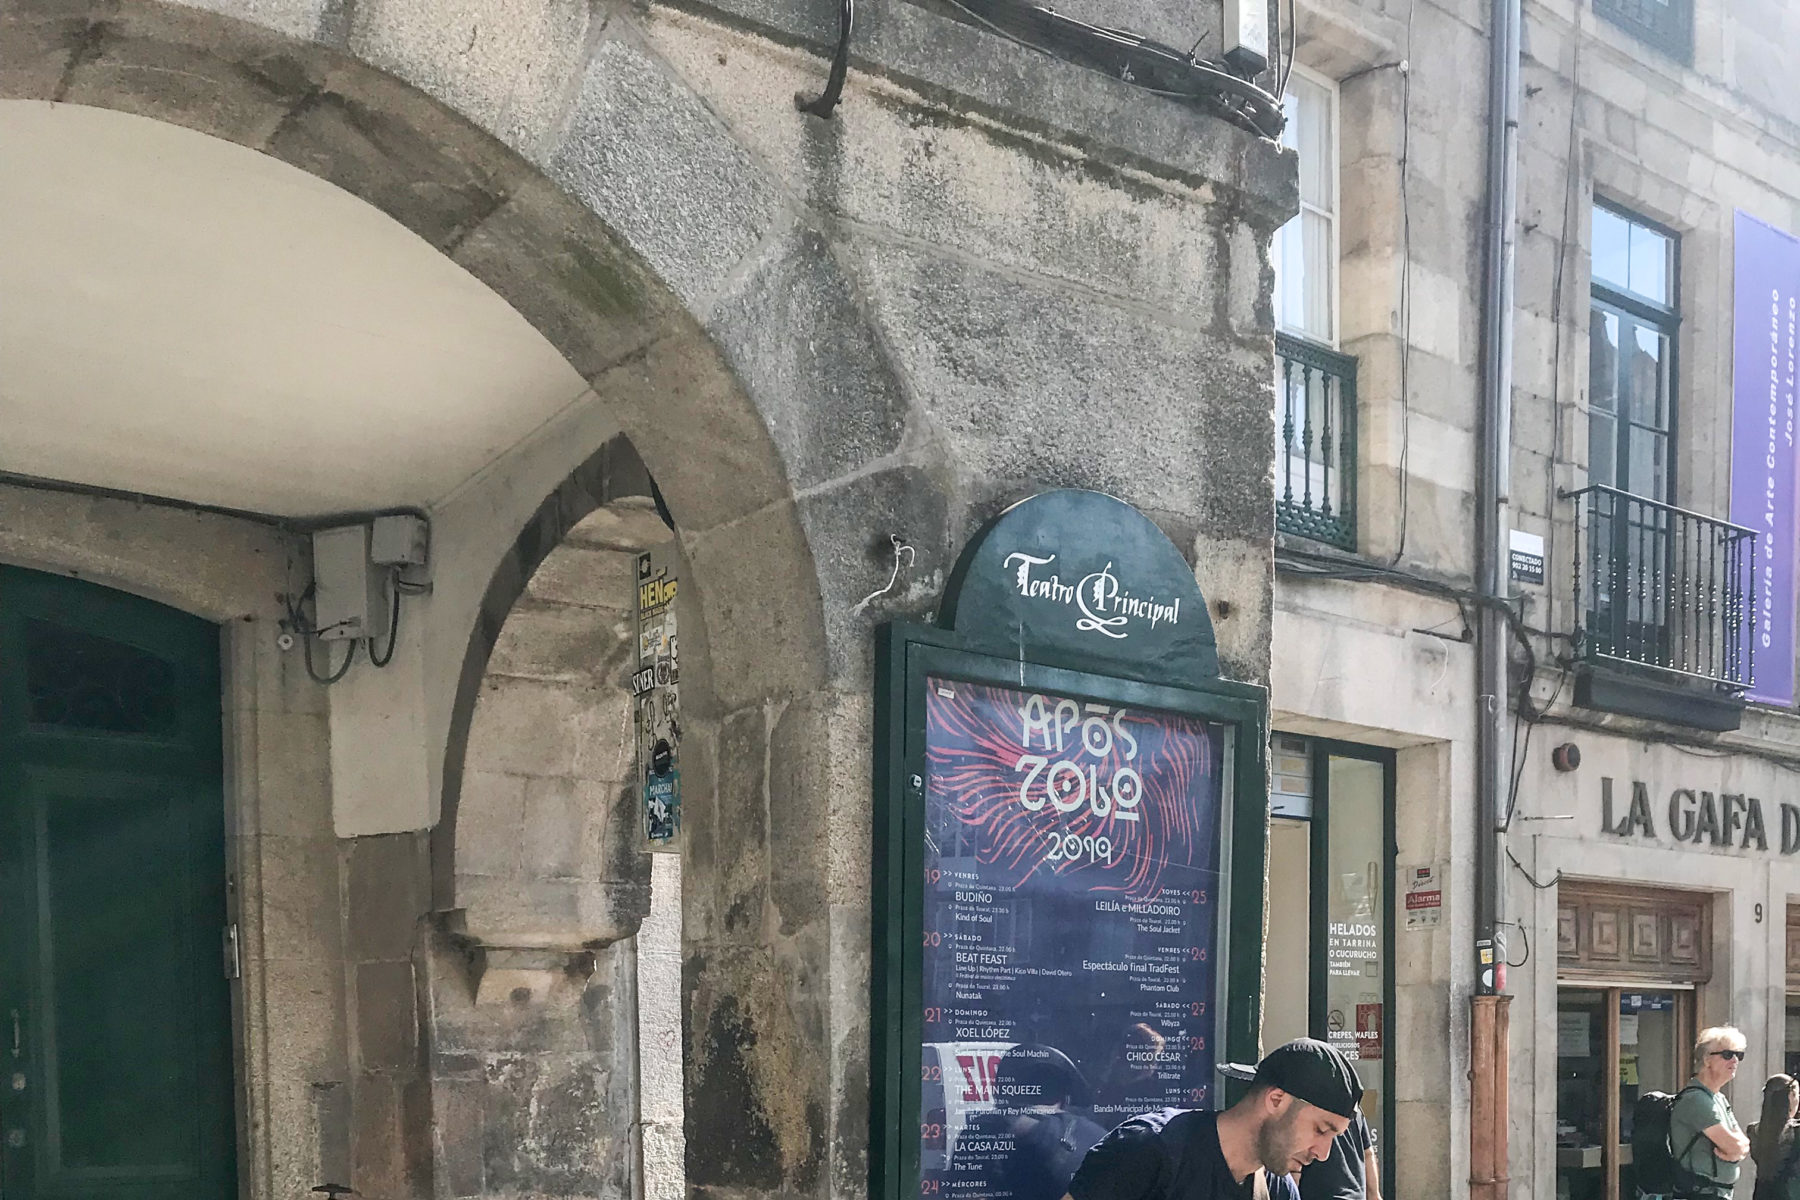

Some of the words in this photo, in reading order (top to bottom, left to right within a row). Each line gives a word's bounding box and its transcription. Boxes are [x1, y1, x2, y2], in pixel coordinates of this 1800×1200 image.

[1786, 297, 1796, 387] Lorenzo
[1767, 288, 1779, 469] Contemporáneo
[1785, 392, 1794, 448] José
[1765, 477, 1775, 527] Arte
[1764, 532, 1773, 559] de
[1004, 552, 1073, 604] Teatro
[1076, 561, 1180, 638] Principal
[1601, 777, 1656, 838] LA
[1669, 788, 1769, 850] GAFA
[1048, 832, 1111, 865] 2019
[924, 868, 941, 884] 19
[954, 872, 979, 880] VENRES
[955, 891, 992, 903] BUDIÑO
[1191, 889, 1207, 905] 25
[1408, 894, 1440, 903] Alarma
[1095, 900, 1121, 912] LEILÍA
[1128, 903, 1181, 916] MILLADOIRO
[1754, 903, 1763, 923] 9
[955, 913, 970, 921] Kind
[979, 914, 993, 923] Soul
[1137, 924, 1148, 932] The
[1149, 924, 1161, 933] Soul
[1162, 925, 1181, 934] Jacket
[1329, 922, 1376, 937] HELADOS
[923, 932, 941, 947] 20
[1329, 938, 1340, 947] EN
[1342, 938, 1377, 948] TARRINA
[956, 952, 978, 963] BEAT
[980, 953, 1008, 964] FEAST
[1191, 946, 1207, 961] 26
[1329, 949, 1335, 958] O
[1335, 949, 1377, 959] CUCURUCHO
[967, 965, 976, 973] Up
[1082, 960, 1129, 972] Espectáculo
[1130, 963, 1148, 972] final
[1148, 963, 1180, 974] TradFest
[1330, 960, 1351, 968] TAMBIÉN
[1342, 969, 1360, 977] LLEVAR
[1140, 983, 1166, 992] Phantom
[1166, 984, 1179, 993] Club
[955, 991, 982, 1000] Nunatak
[924, 1007, 941, 1023] 21
[954, 1009, 988, 1017] DOMINGO
[1191, 1002, 1206, 1016] 27
[956, 1027, 980, 1038] XOEL
[981, 1026, 1010, 1039] LÓPEZ
[1328, 1031, 1354, 1040] CREPES,
[1354, 1031, 1378, 1039] WAFLES
[1012, 1049, 1026, 1058] Soul
[1126, 1051, 1154, 1062] CHICO
[1154, 1050, 1181, 1062] CÉSAR
[921, 1065, 941, 1081] 22
[954, 1085, 974, 1095] THE
[975, 1085, 1000, 1095] MAIN
[1001, 1085, 1042, 1096] SQUEEZE
[1191, 1088, 1205, 1102] 29
[1007, 1108, 1020, 1116] Rey
[1093, 1104, 1114, 1113] Banda
[1114, 1104, 1144, 1114] Municipal
[1144, 1104, 1153, 1113] de
[920, 1123, 941, 1139] 23
[954, 1142, 966, 1152] LA
[967, 1141, 992, 1152] CASA
[993, 1141, 1016, 1151] AZUL
[954, 1163, 966, 1171] The
[967, 1163, 983, 1171] Tune
[921, 1180, 939, 1195] 24
